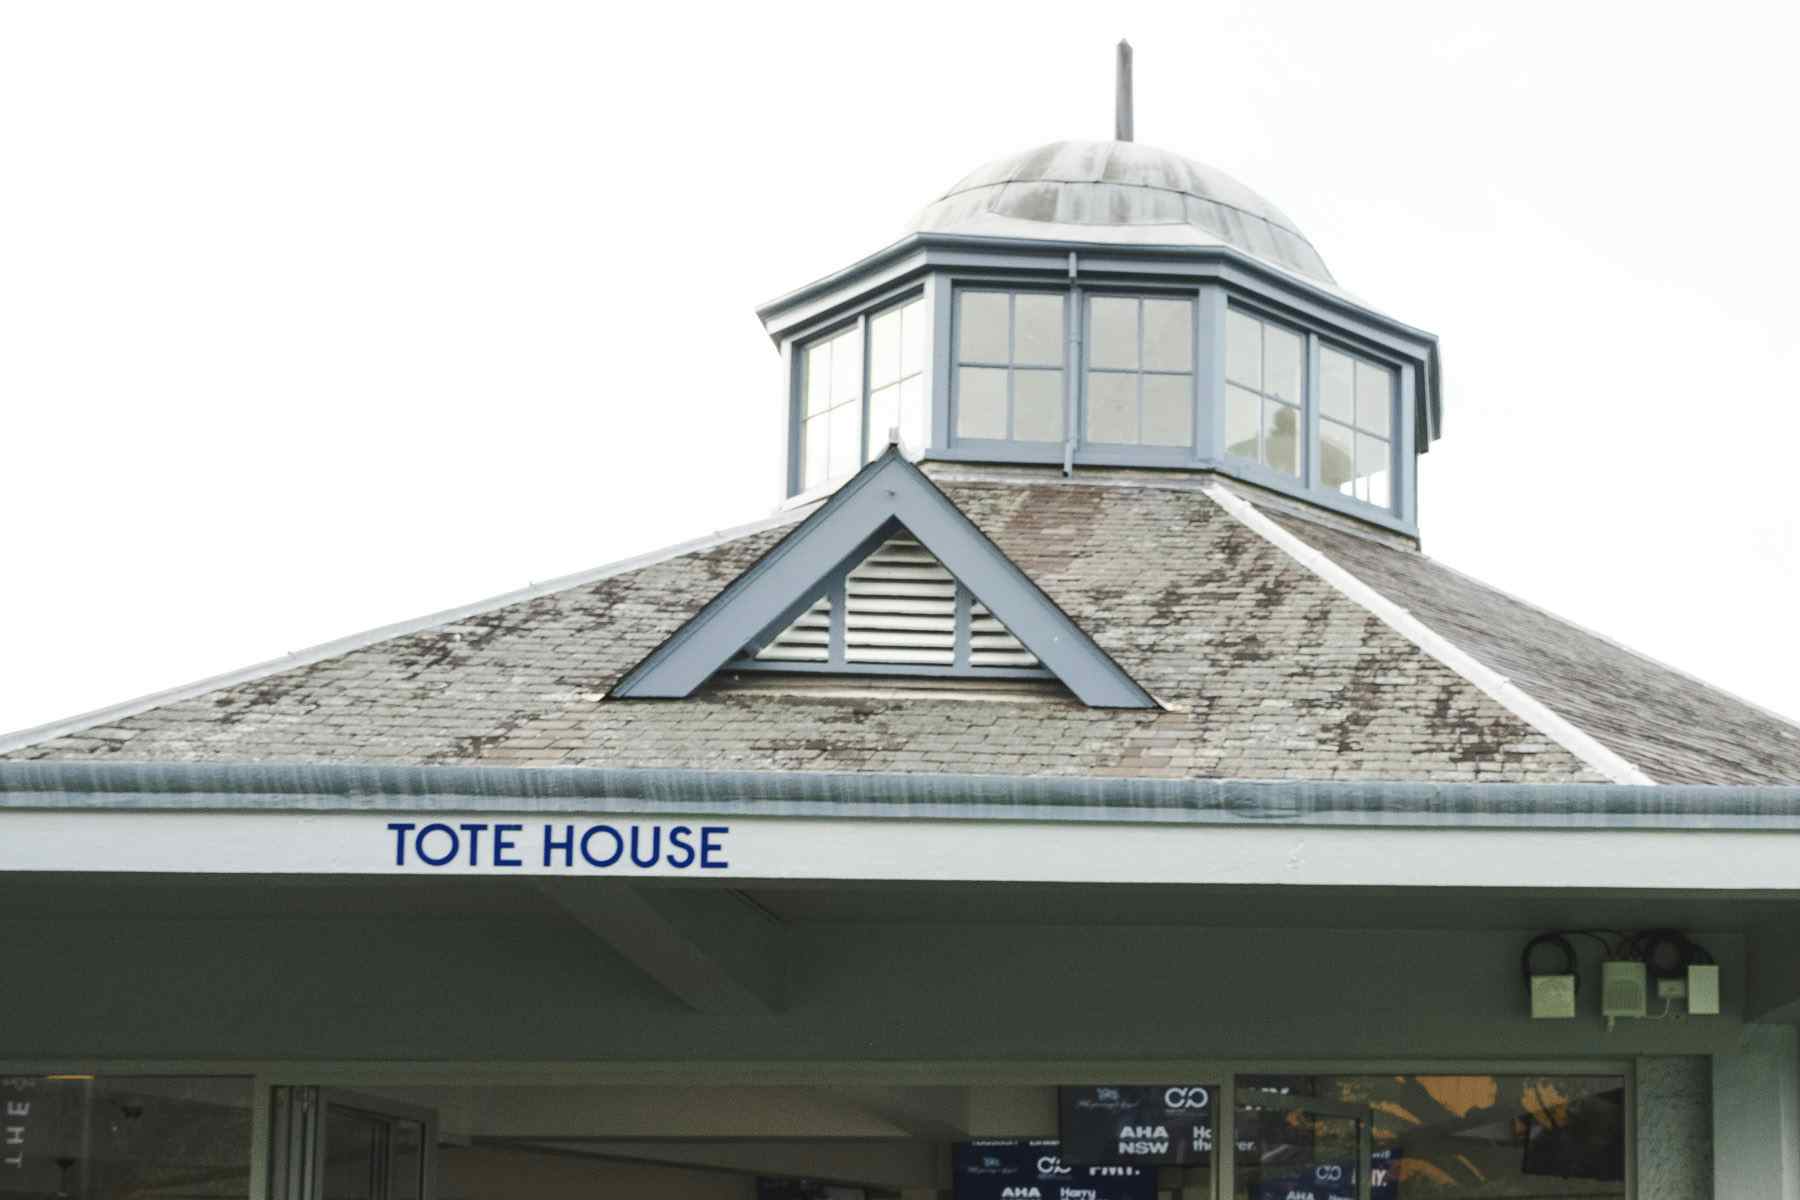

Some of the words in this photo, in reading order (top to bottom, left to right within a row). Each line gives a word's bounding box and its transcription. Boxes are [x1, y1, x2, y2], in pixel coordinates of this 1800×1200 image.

[387, 823, 523, 867] TOTE
[542, 825, 730, 869] HOUSE
[1119, 1125, 1169, 1139] AHA
[1118, 1141, 1169, 1154] NSW
[1001, 1186, 1041, 1198] AHA
[1060, 1187, 1097, 1200] Harry
